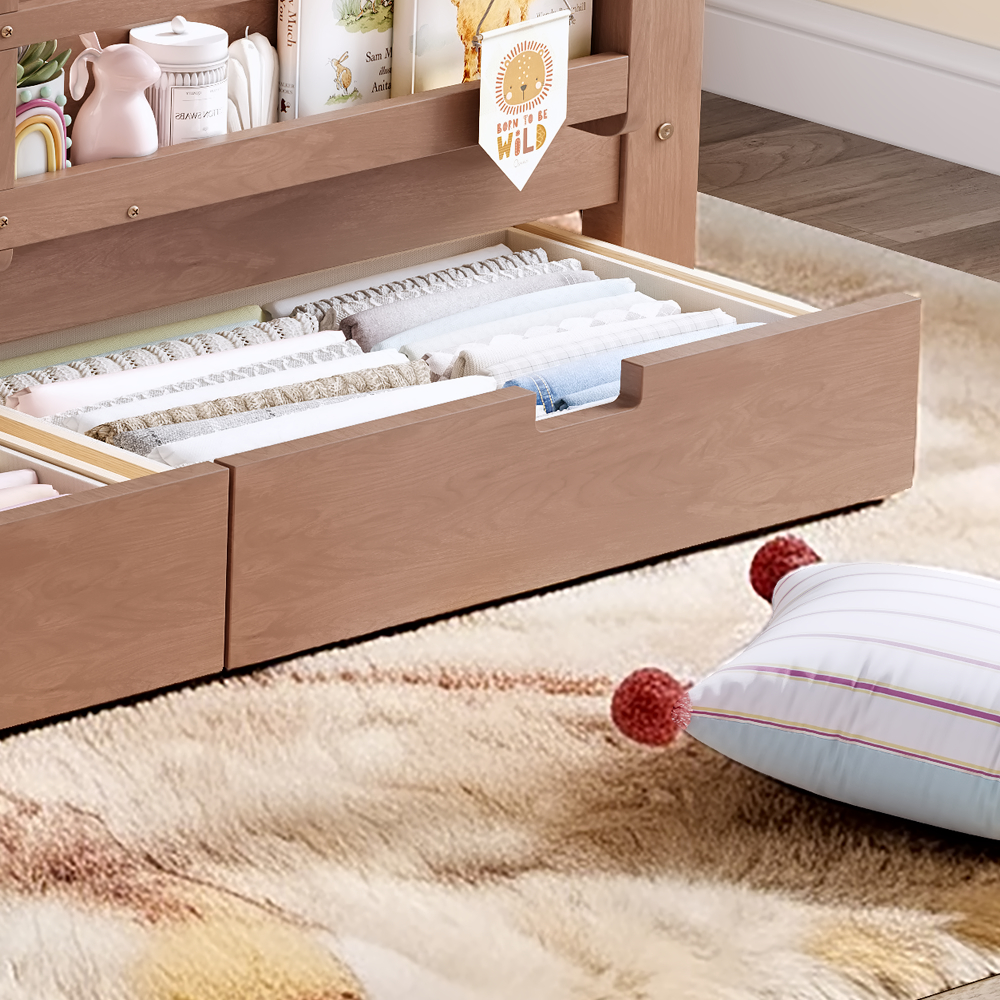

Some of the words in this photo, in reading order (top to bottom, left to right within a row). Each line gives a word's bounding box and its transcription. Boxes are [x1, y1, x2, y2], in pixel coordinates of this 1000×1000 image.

[286, 9, 298, 48] Much
[365, 51, 383, 63] Sam
[384, 46, 393, 60] M
[371, 79, 392, 94] Anita
[496, 118, 519, 135] BORN
[523, 113, 534, 126] TO
[537, 108, 548, 122] BE
